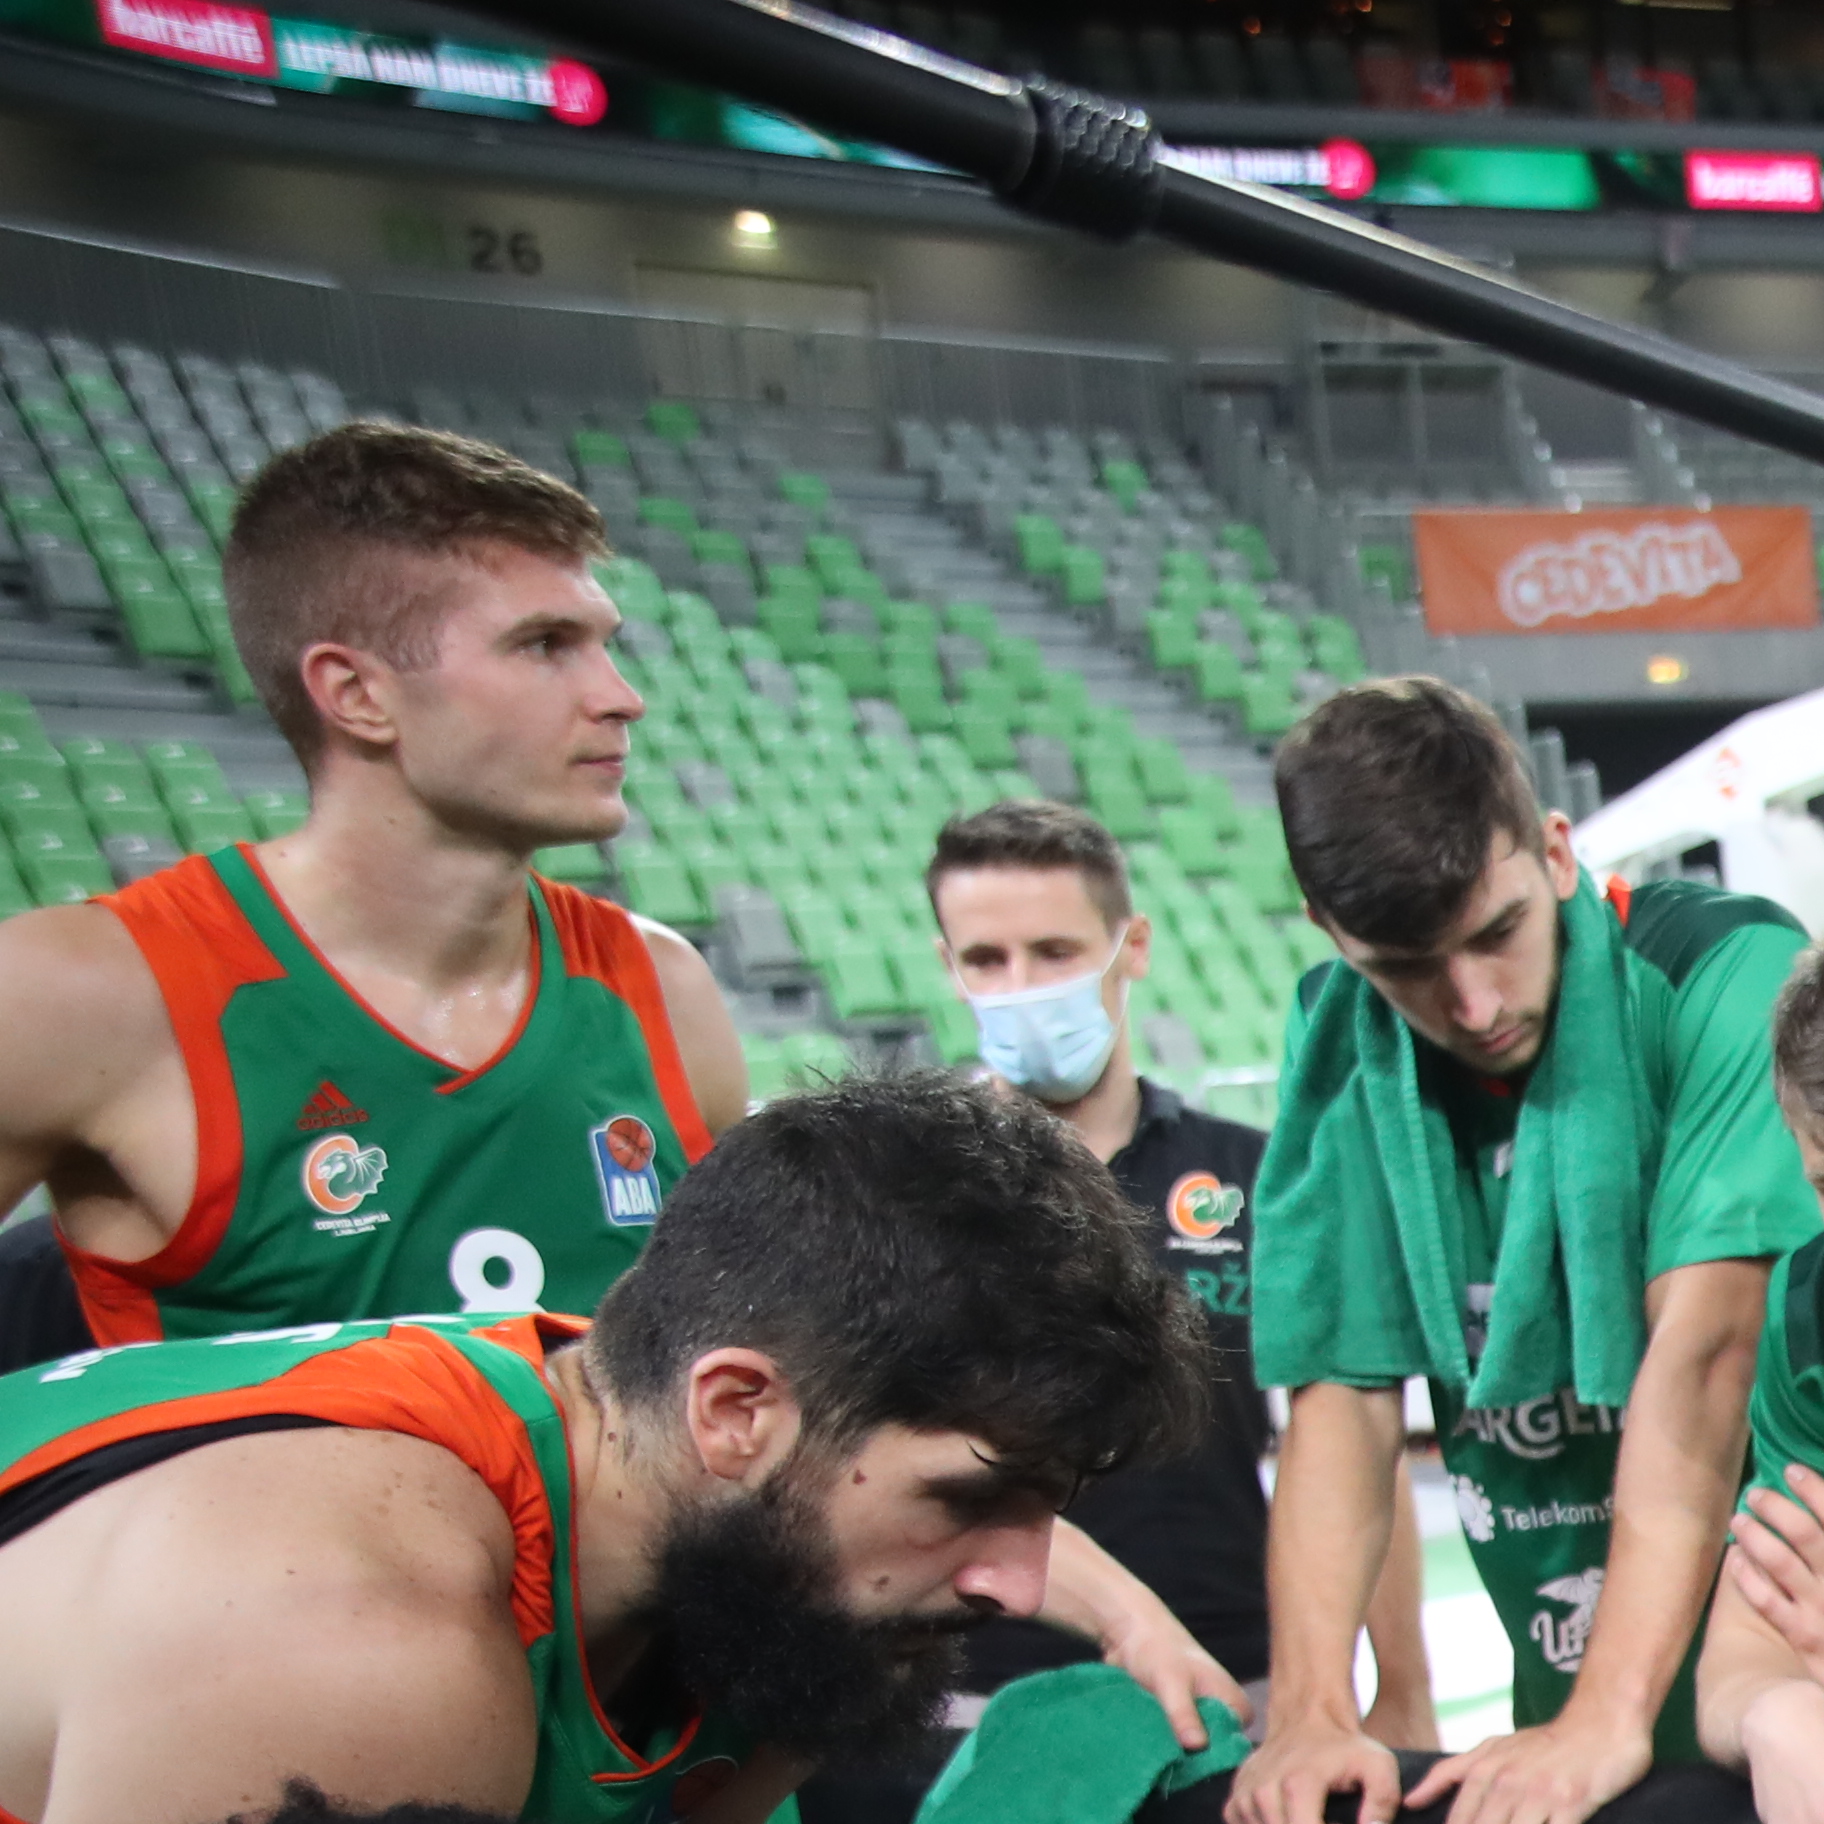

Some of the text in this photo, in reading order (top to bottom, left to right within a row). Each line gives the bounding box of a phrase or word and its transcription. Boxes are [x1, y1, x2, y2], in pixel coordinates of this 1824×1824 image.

[466, 223, 545, 277] 26
[612, 1176, 658, 1217] ABA
[1453, 1385, 1626, 1460] ARGET
